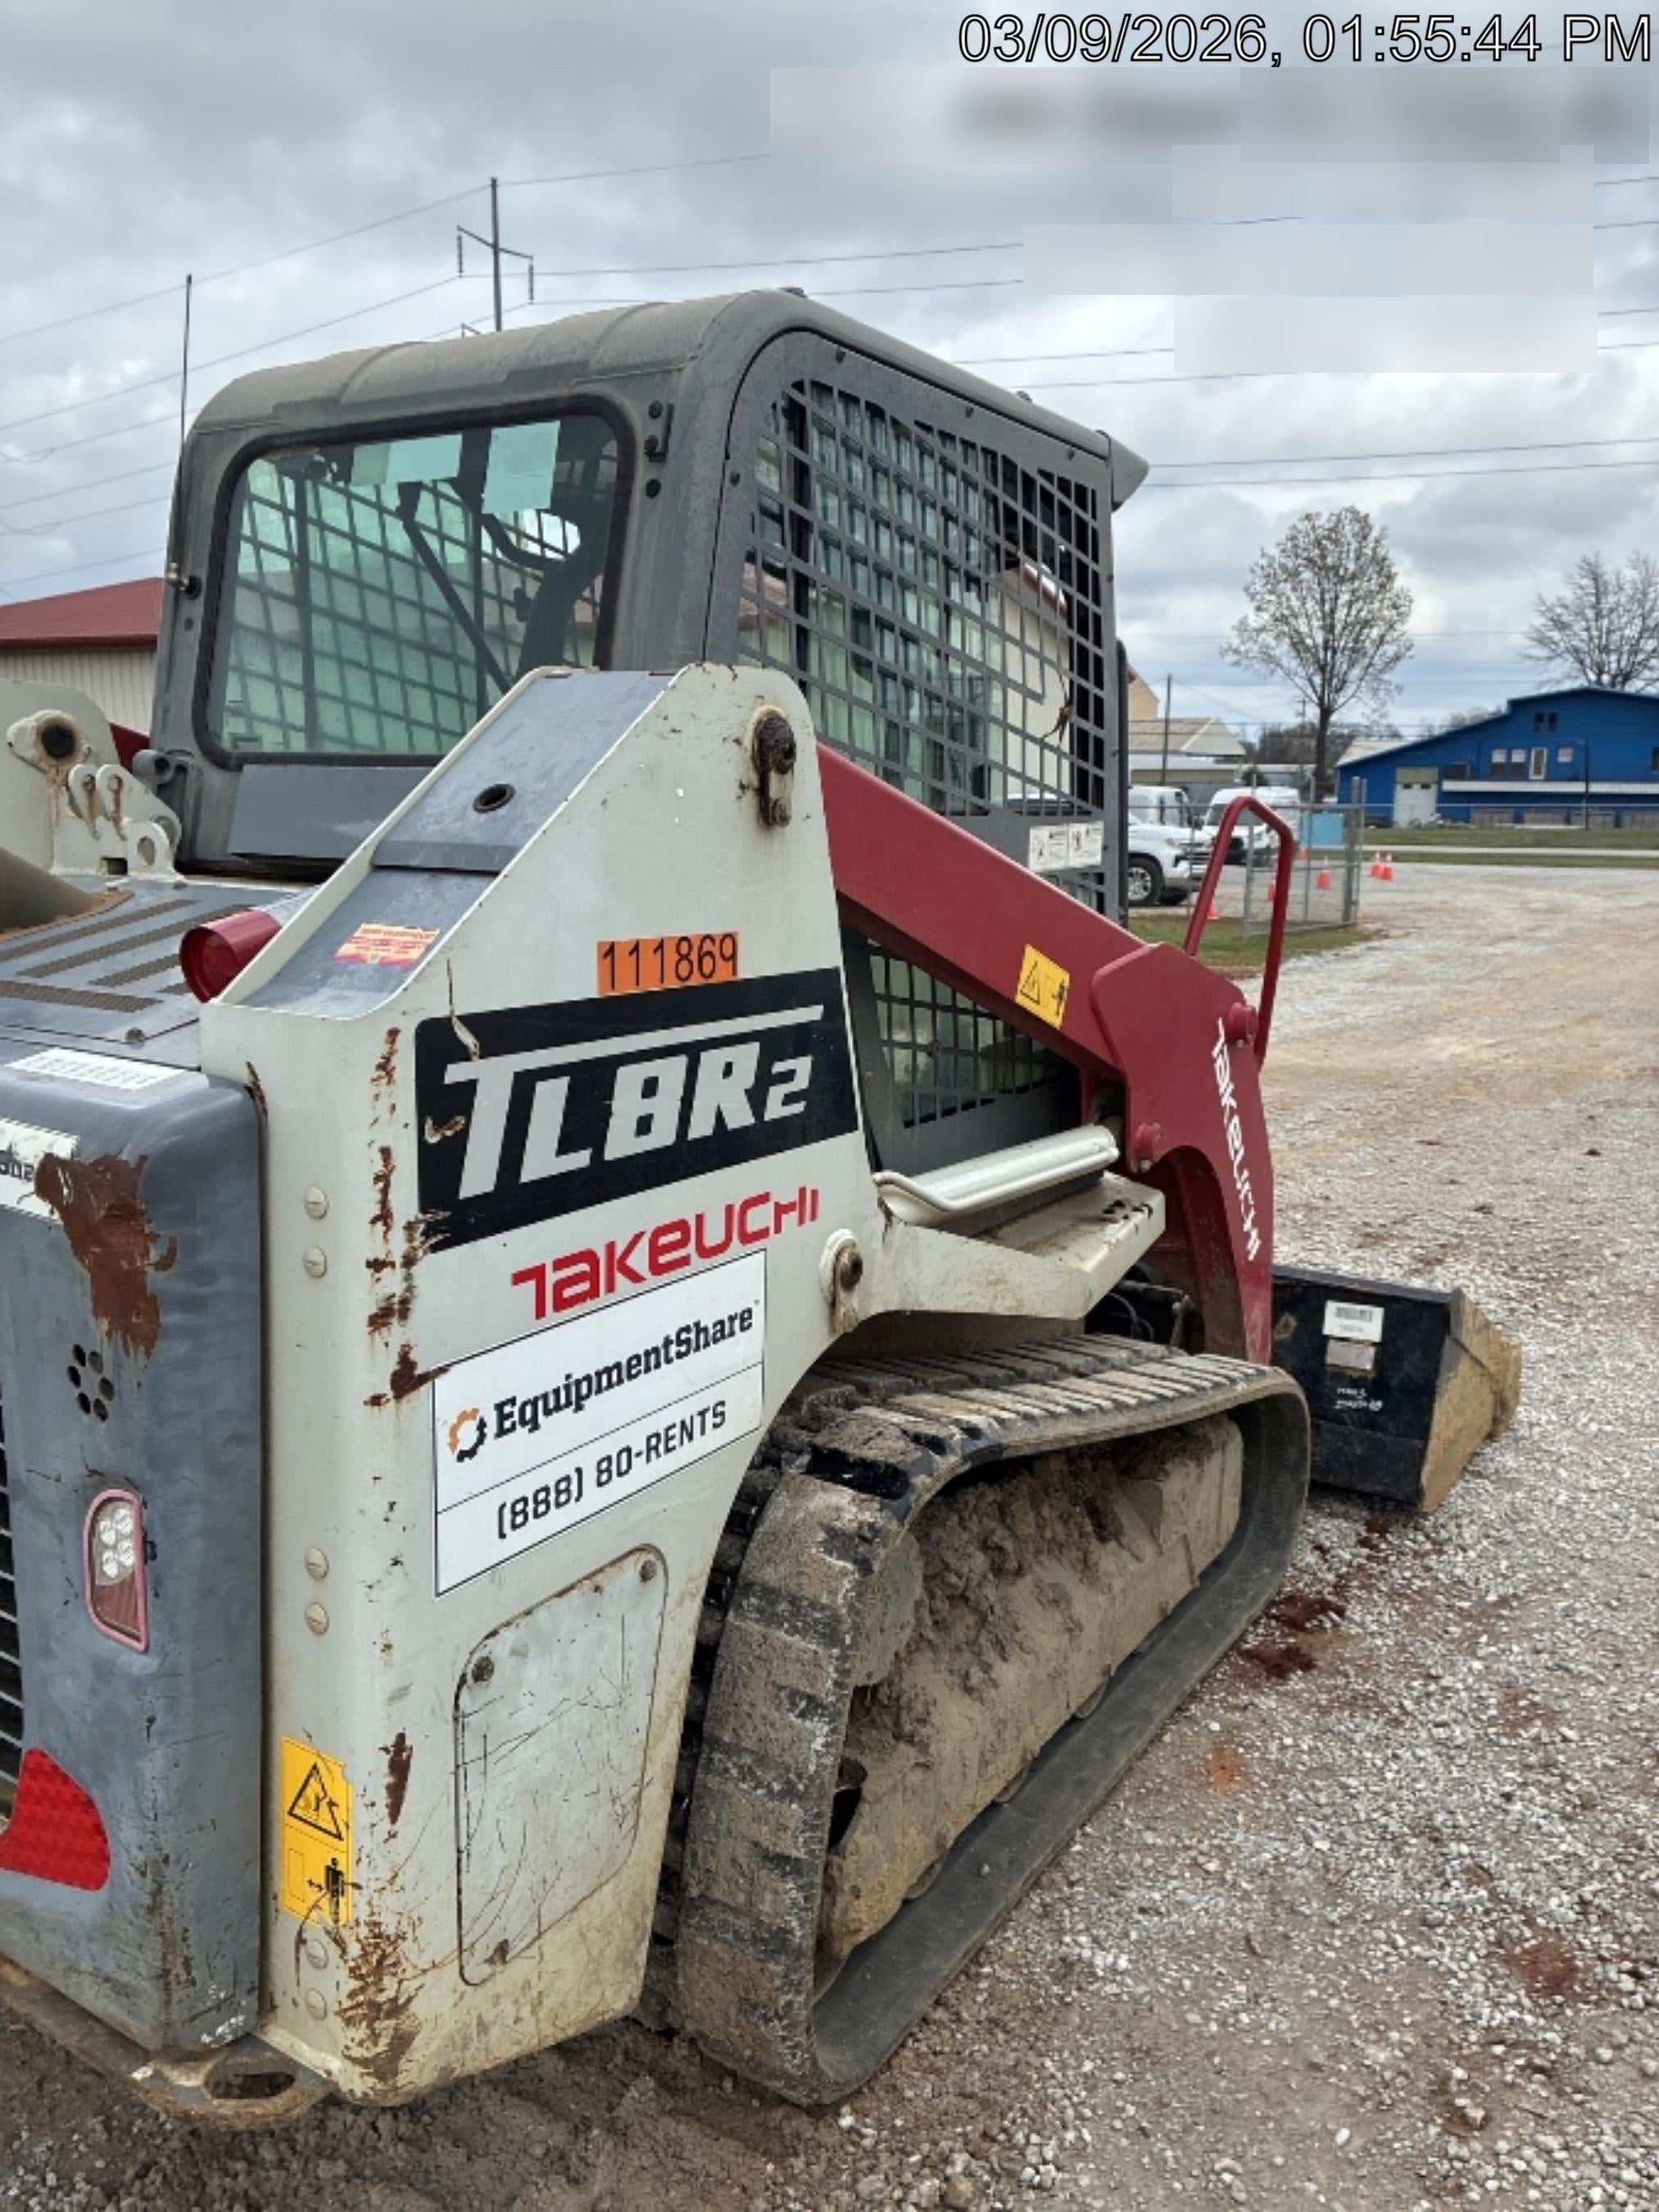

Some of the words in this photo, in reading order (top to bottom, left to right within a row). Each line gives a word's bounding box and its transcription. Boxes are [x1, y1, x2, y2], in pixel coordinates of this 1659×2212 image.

[601, 932, 738, 991] 111869
[511, 1186, 819, 1320] TAKEUCHI
[493, 1307, 754, 1440] EquipmentShare
[497, 1466, 583, 1539] (888)
[596, 1400, 727, 1488] 80-RENTS
